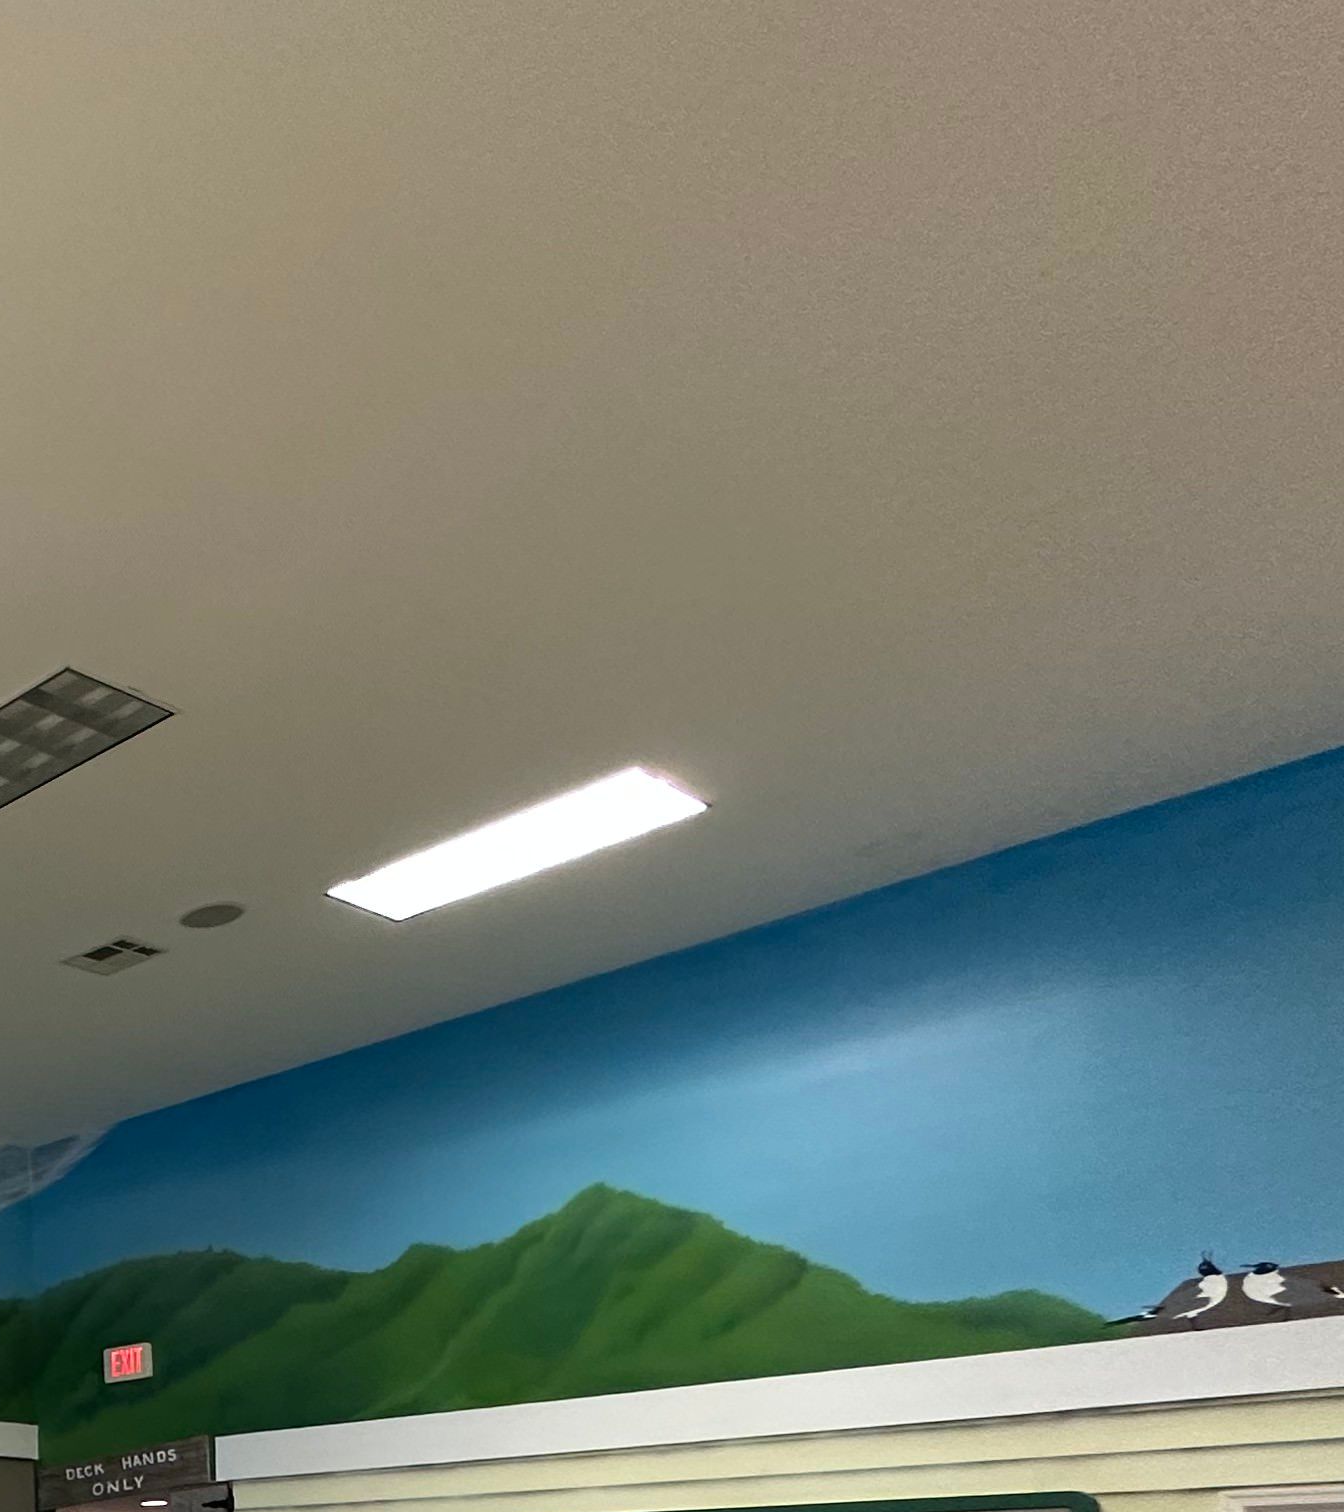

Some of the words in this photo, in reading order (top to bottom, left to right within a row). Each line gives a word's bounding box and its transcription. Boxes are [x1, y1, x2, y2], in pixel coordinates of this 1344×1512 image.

[111, 1346, 143, 1378] EXIT
[65, 1464, 104, 1481] DECK
[121, 1449, 177, 1470] HANDS
[92, 1475, 144, 1496] ONLY
